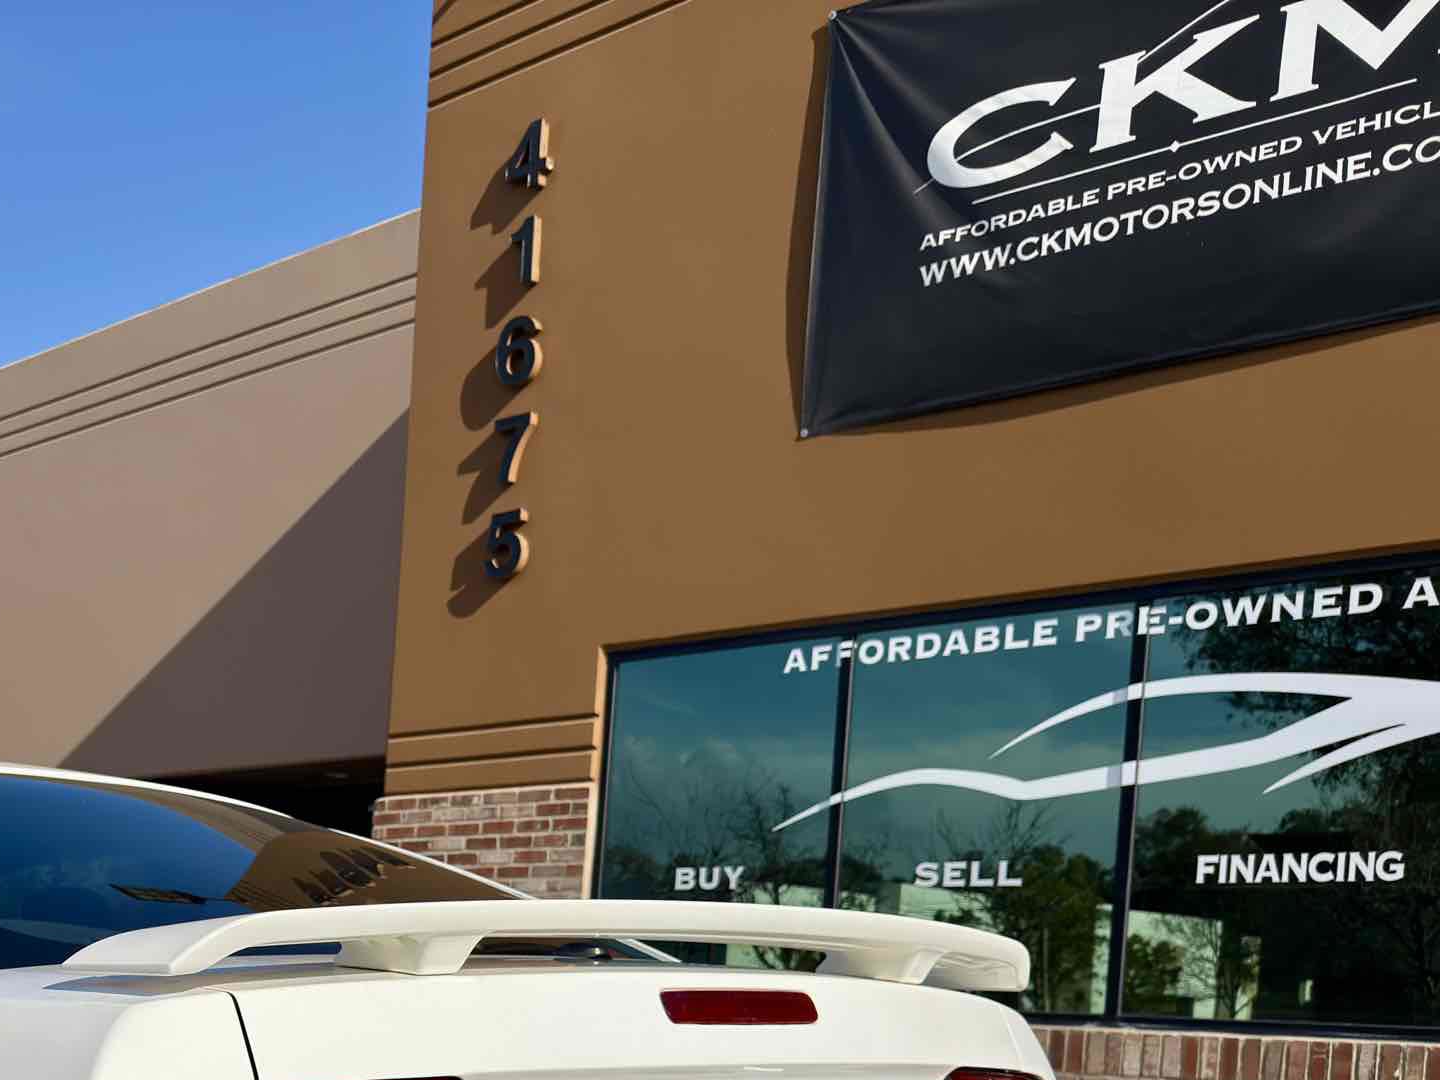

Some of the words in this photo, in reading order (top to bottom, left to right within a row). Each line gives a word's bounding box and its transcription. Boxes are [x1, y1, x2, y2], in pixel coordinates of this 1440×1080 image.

[926, 0, 1440, 188] CKM
[919, 188, 1101, 251] AFFORDABLE
[1107, 136, 1303, 200] PRE-OWNED
[1311, 101, 1440, 145] VEHICL
[919, 135, 1440, 288] WWW.CKMOTORSONLINE.CO
[483, 117, 555, 579] 41675
[783, 618, 1059, 674] AFFORDABLE
[1074, 583, 1384, 642] PRE-OWNED
[674, 865, 746, 892] BUY
[914, 860, 1023, 888] SELL
[1195, 849, 1405, 885] FINANCING
